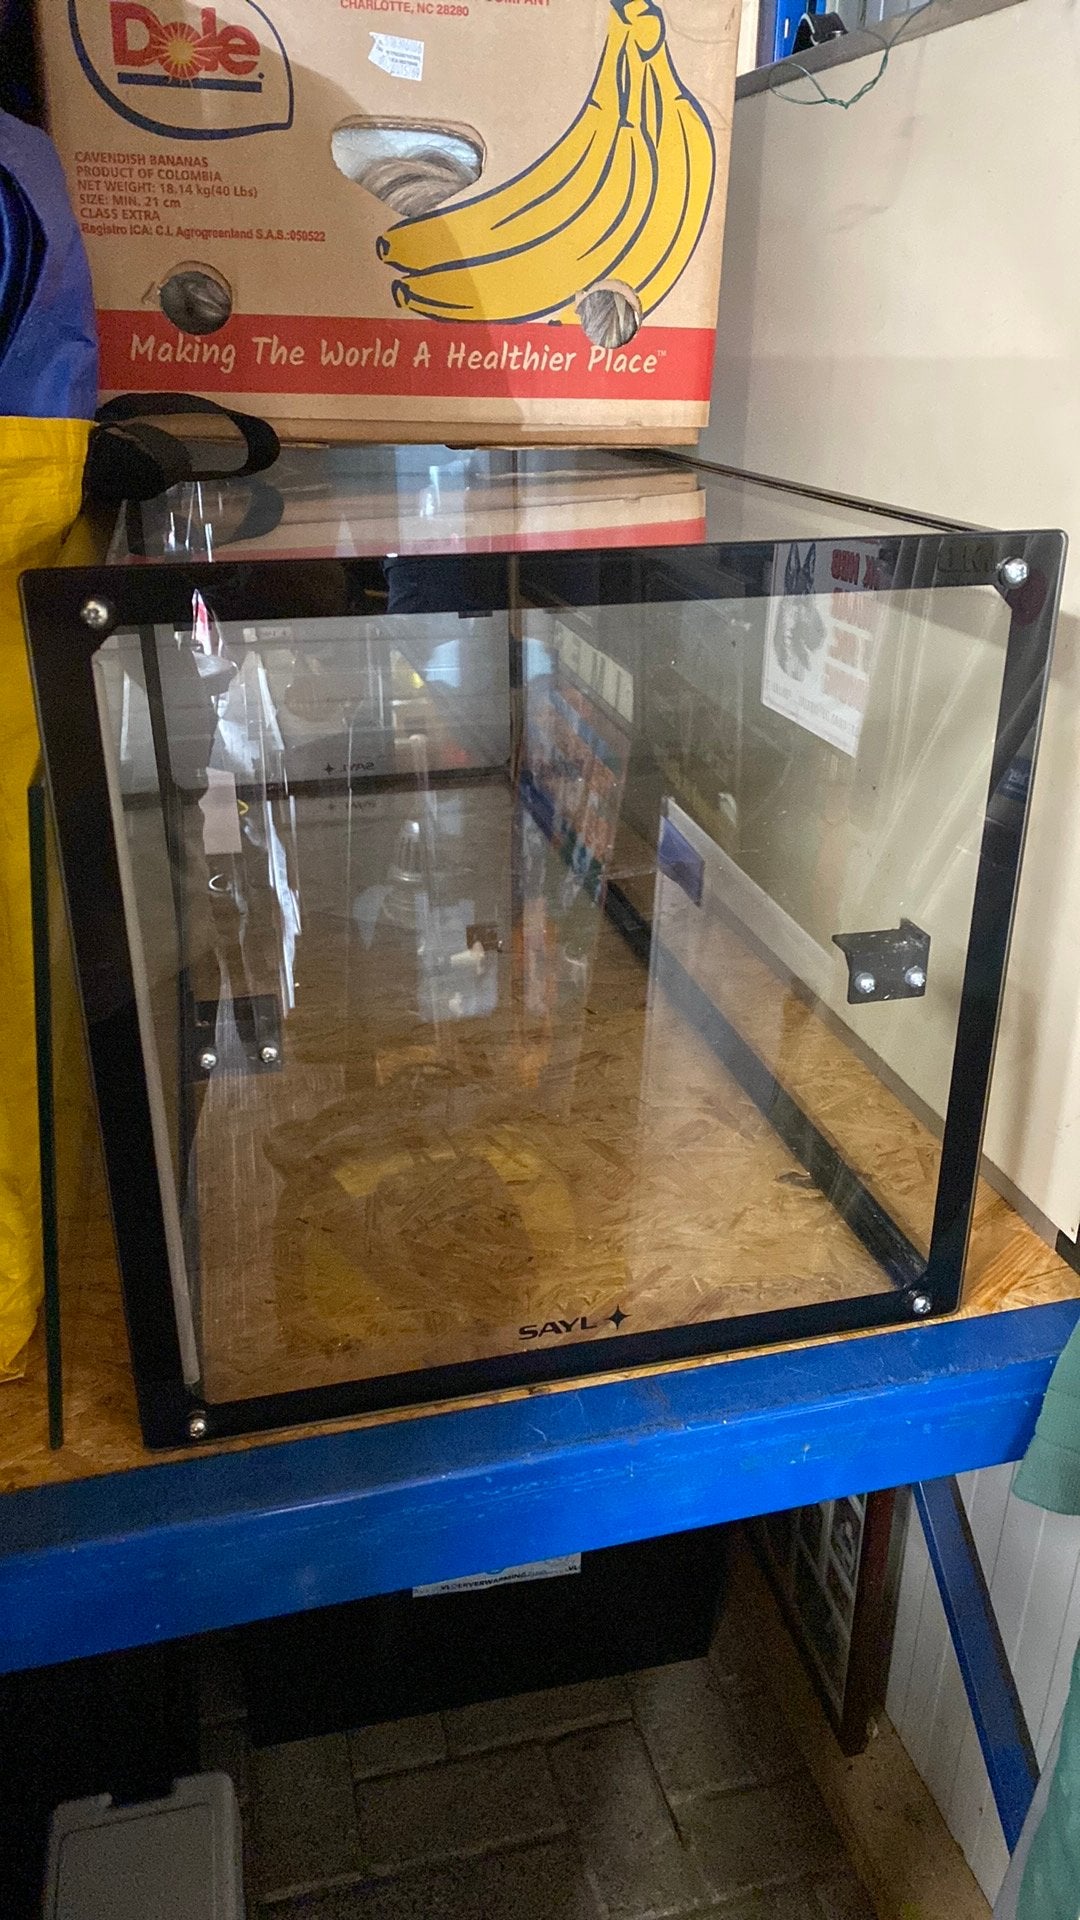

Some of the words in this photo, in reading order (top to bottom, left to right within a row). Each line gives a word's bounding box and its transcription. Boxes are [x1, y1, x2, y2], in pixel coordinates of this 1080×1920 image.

[341, 0, 414, 14] CHARLOTTE,
[417, 4, 434, 14] NC
[437, 5, 469, 16] 28280
[110, 1, 261, 79] Dole
[75, 151, 146, 165] CAVENDISH
[150, 154, 209, 167] BANANAS
[76, 165, 134, 178] PRODUCT
[138, 168, 154, 179] OF
[157, 169, 222, 182] COLOMBIA
[77, 180, 101, 191] NET
[104, 181, 156, 193] WEIGHT:
[160, 183, 193, 195] 18.14
[234, 186, 258, 199] Lbs)
[80, 194, 108, 206] SIZE:
[112, 194, 142, 206] MIN.
[145, 196, 160, 207] 21
[163, 199, 181, 208] cm
[80, 207, 118, 220] CLASS
[122, 209, 160, 221] EXTRA
[81, 222, 128, 236] Registro
[131, 332, 236, 374] Making
[252, 335, 305, 366] The
[321, 338, 400, 368] World
[413, 341, 431, 368] A
[447, 341, 577, 371] Healthier
[518, 1316, 598, 1340] SAYL
